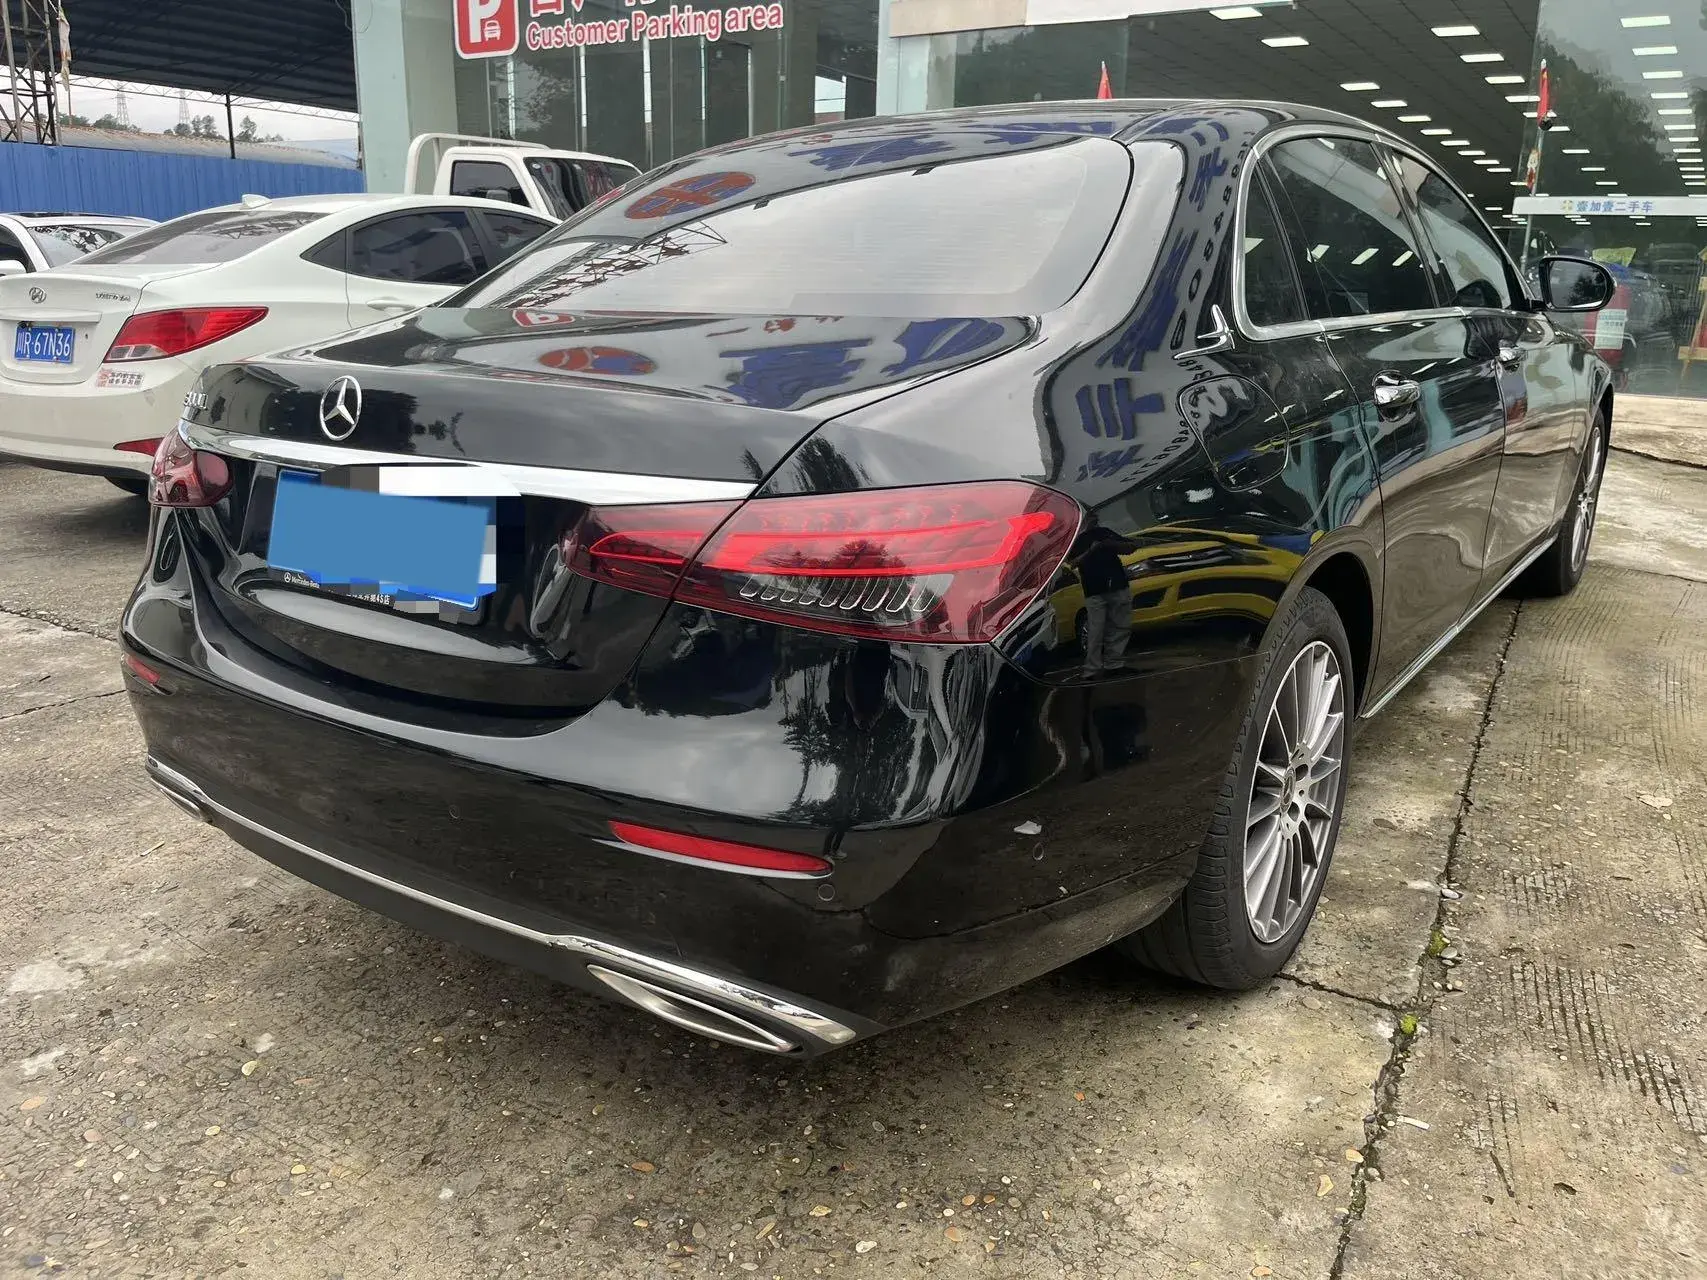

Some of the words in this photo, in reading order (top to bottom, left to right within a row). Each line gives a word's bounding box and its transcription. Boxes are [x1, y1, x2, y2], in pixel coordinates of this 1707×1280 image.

[526, 19, 629, 50] Customer
[631, 6, 722, 41] Parking
[725, 3, 784, 32] area
